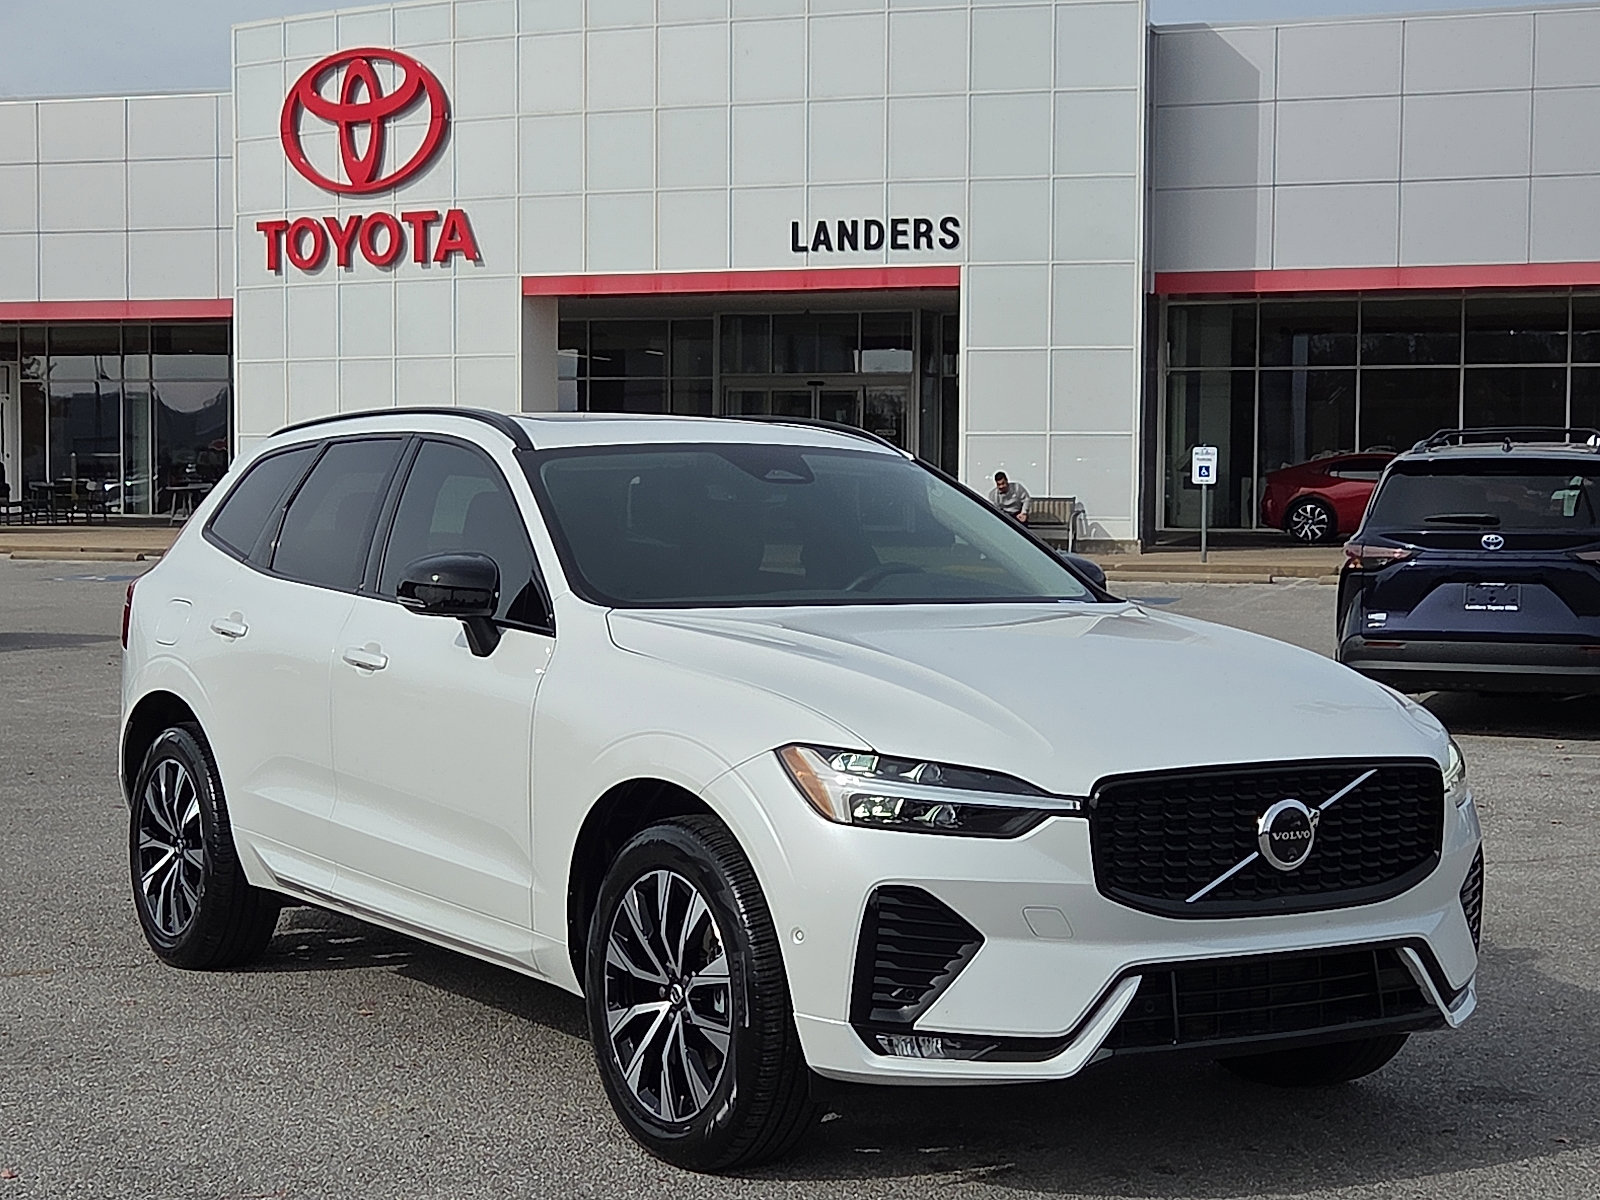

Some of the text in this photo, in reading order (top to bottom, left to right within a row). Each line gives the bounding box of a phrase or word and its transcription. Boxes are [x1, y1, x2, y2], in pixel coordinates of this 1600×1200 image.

[257, 209, 481, 271] TOYOTA
[791, 216, 961, 252] LANDERS
[1272, 830, 1310, 840] VOLVO
